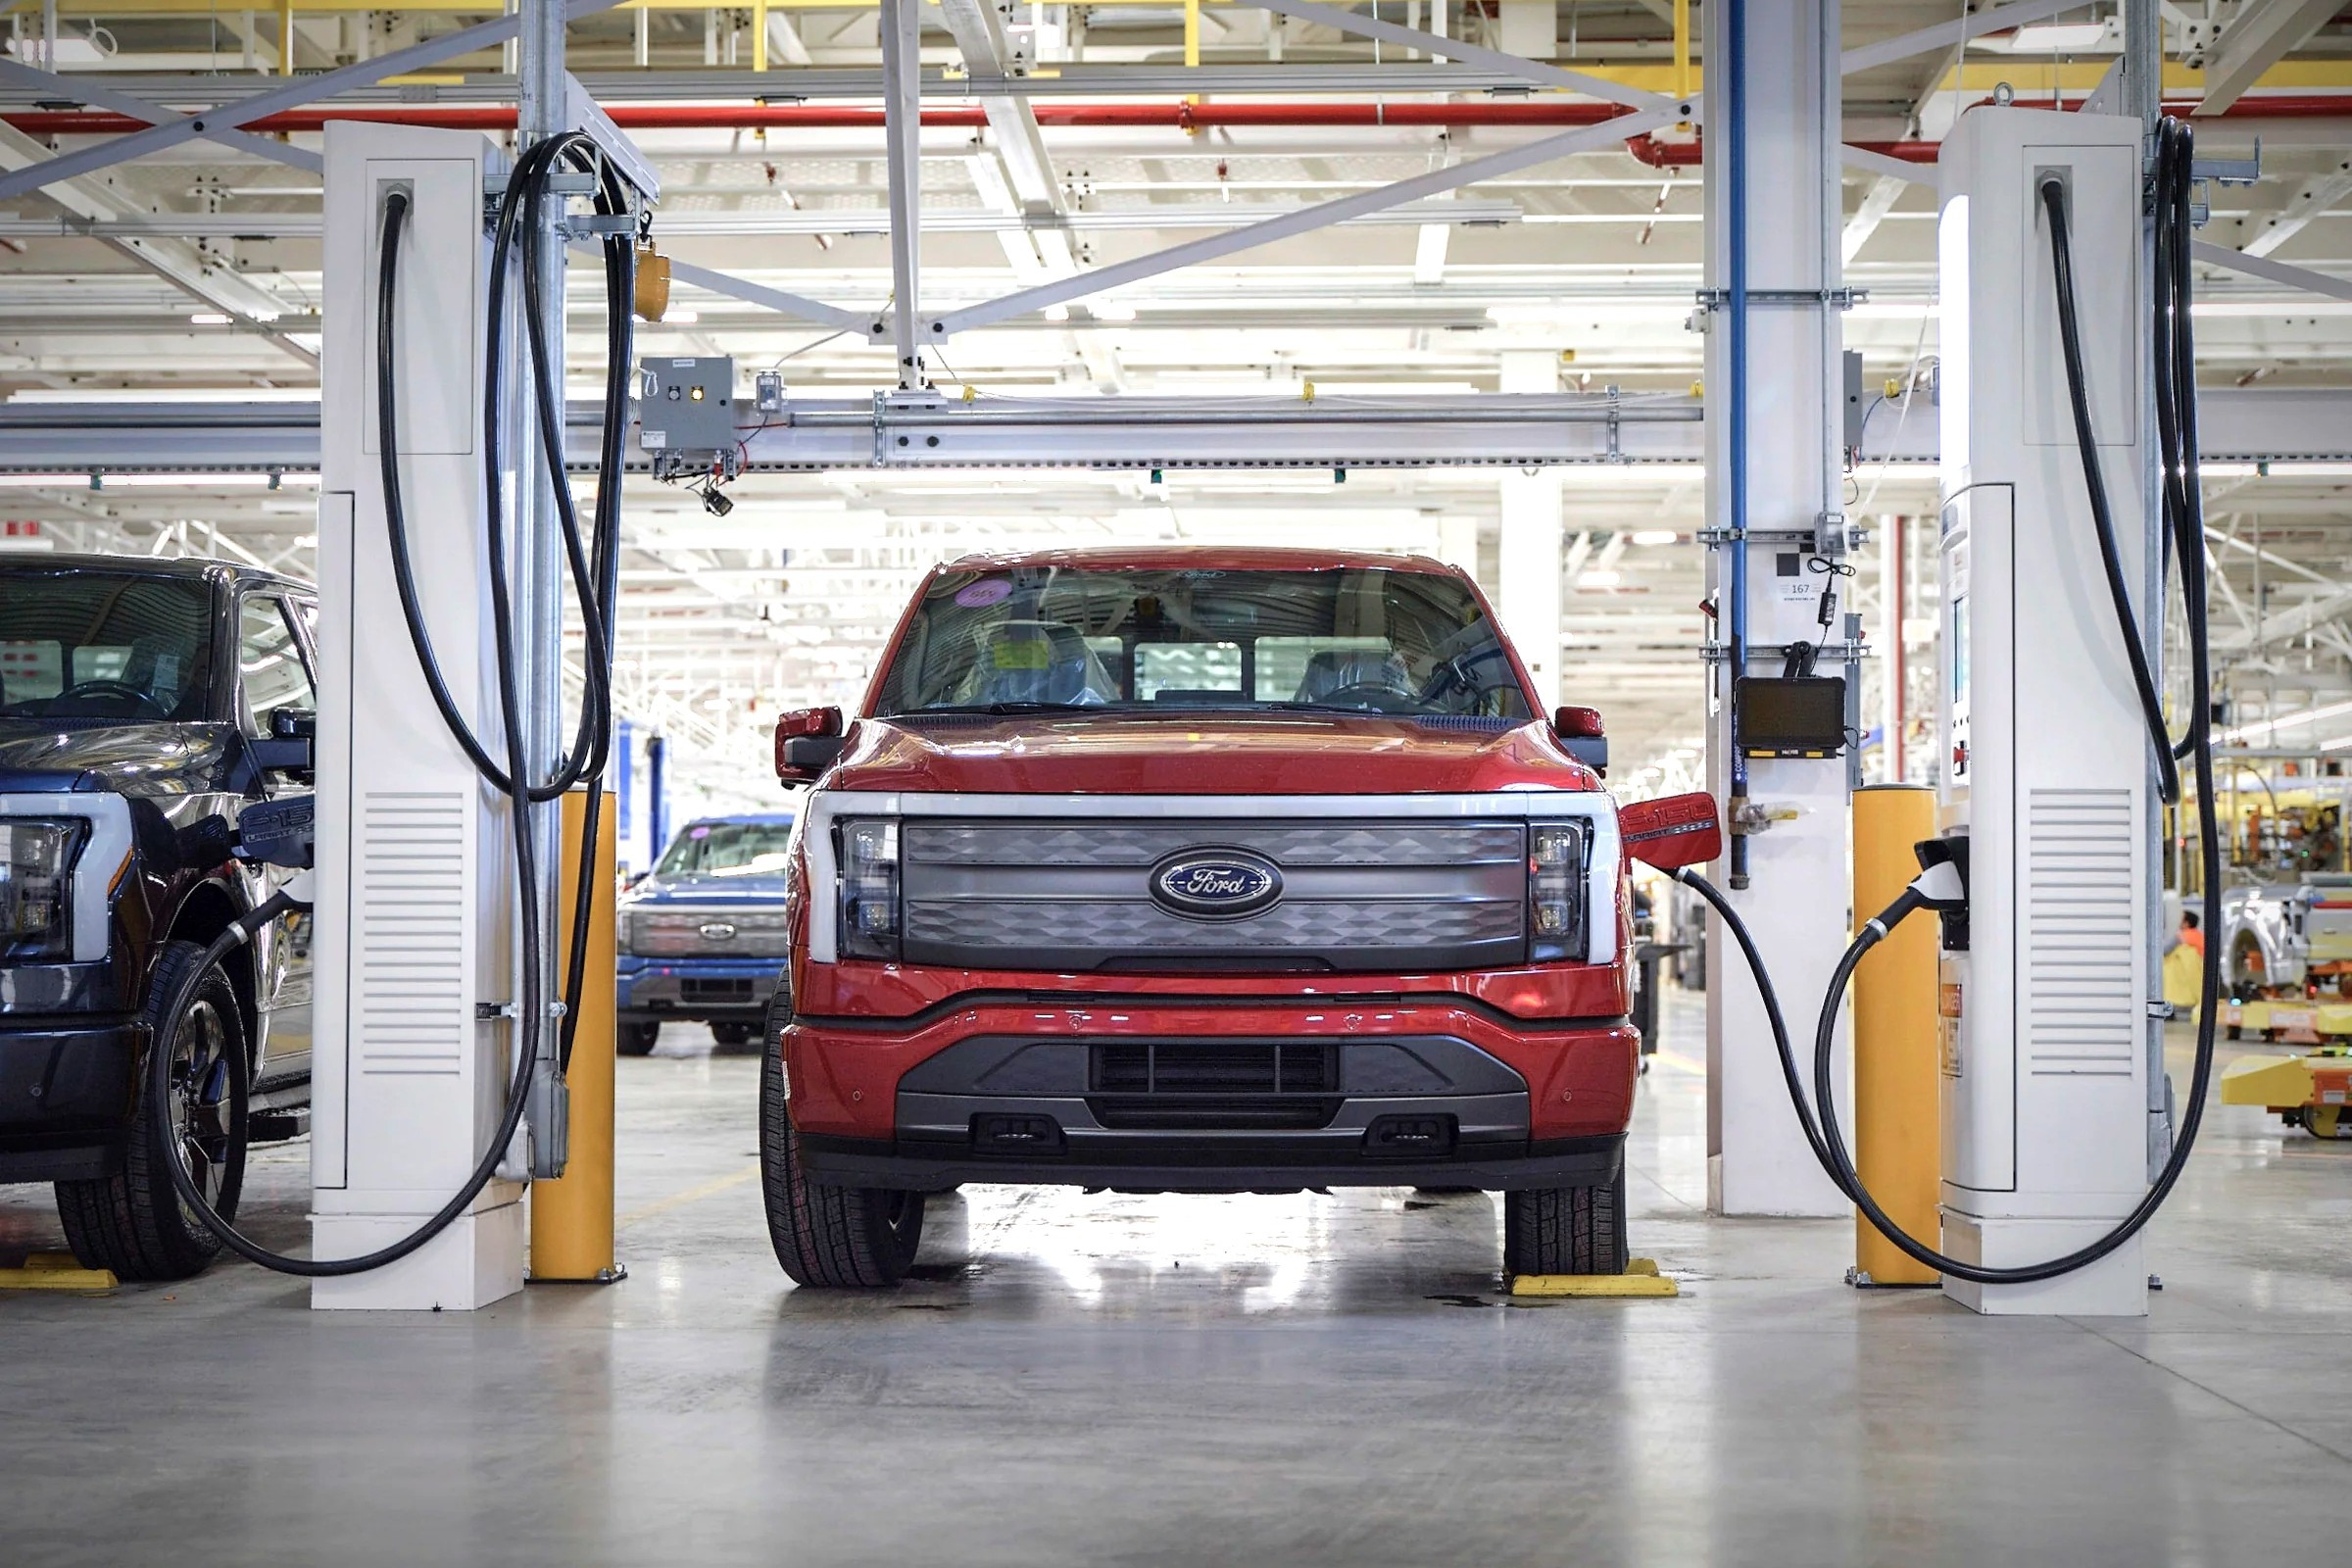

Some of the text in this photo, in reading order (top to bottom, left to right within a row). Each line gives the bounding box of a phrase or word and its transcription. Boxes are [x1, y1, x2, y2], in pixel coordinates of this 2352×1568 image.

[1792, 584, 1810, 594] 167
[241, 804, 315, 832] F-15
[1619, 800, 1715, 832] F-150
[1187, 868, 1247, 894] Ford
